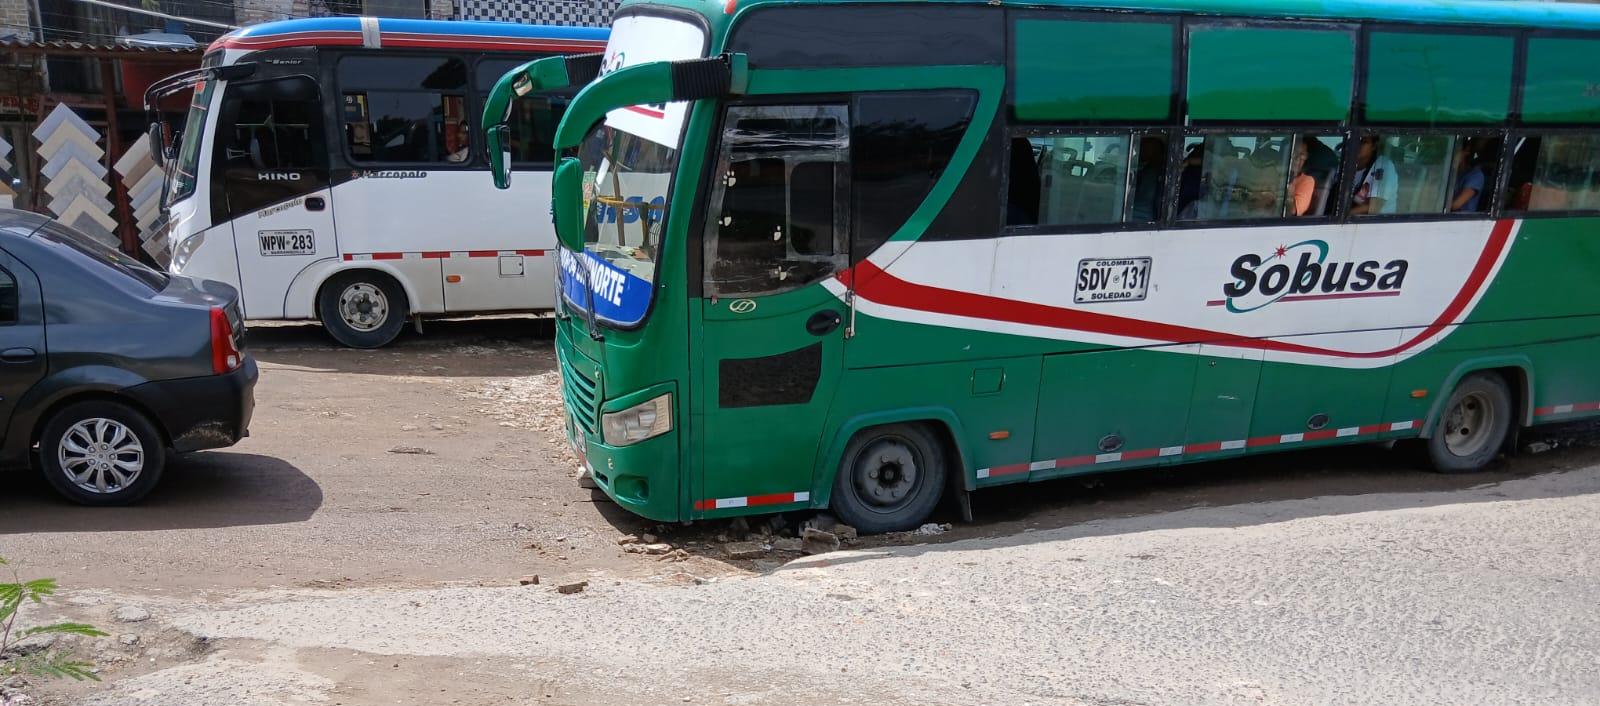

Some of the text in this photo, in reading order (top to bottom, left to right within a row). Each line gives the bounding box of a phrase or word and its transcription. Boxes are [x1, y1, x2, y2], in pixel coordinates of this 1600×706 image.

[258, 172, 301, 181] HINO
[363, 170, 428, 180] Marcopolo
[261, 234, 313, 251] WPW 283
[1078, 266, 1147, 291] SDV 131
[1223, 252, 1409, 298] Sobusa
[1090, 292, 1132, 300] SOLEDAD
